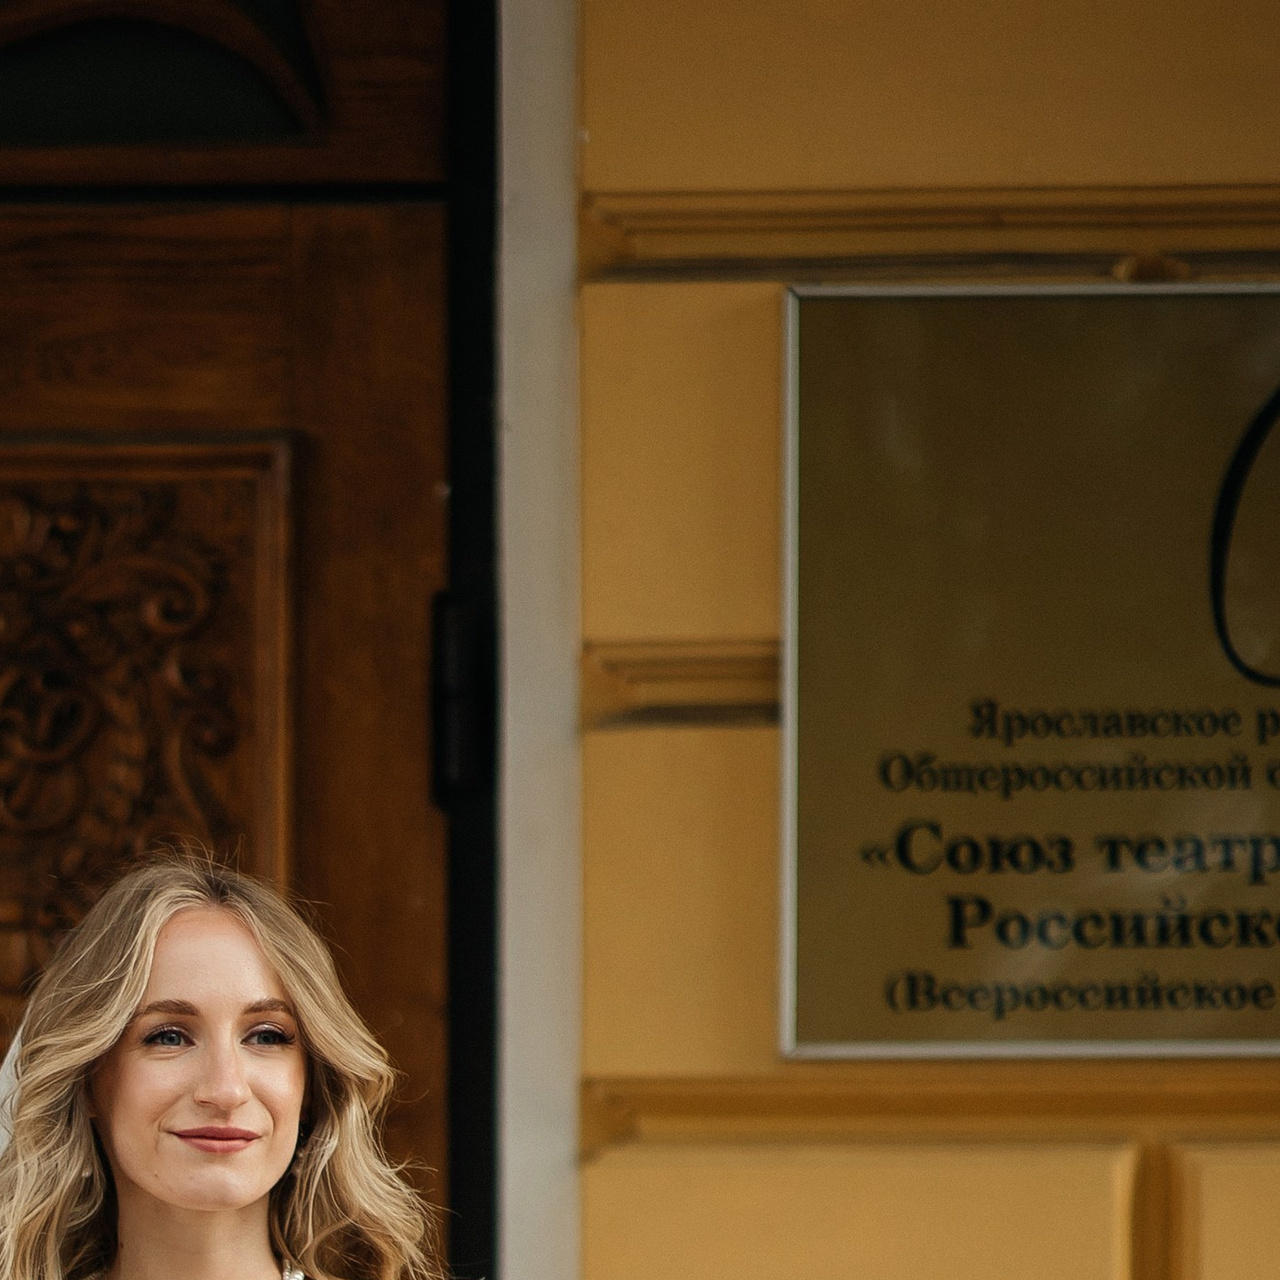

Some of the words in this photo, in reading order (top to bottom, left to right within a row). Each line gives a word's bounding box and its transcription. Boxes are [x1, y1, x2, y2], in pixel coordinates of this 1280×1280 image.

[969, 699, 1242, 745] Ярославское
[879, 751, 1252, 799] Общероссийской
[860, 819, 1075, 875] «Союз
[946, 894, 1280, 949] Российск
[885, 970, 1276, 1019] (Всероссийское
